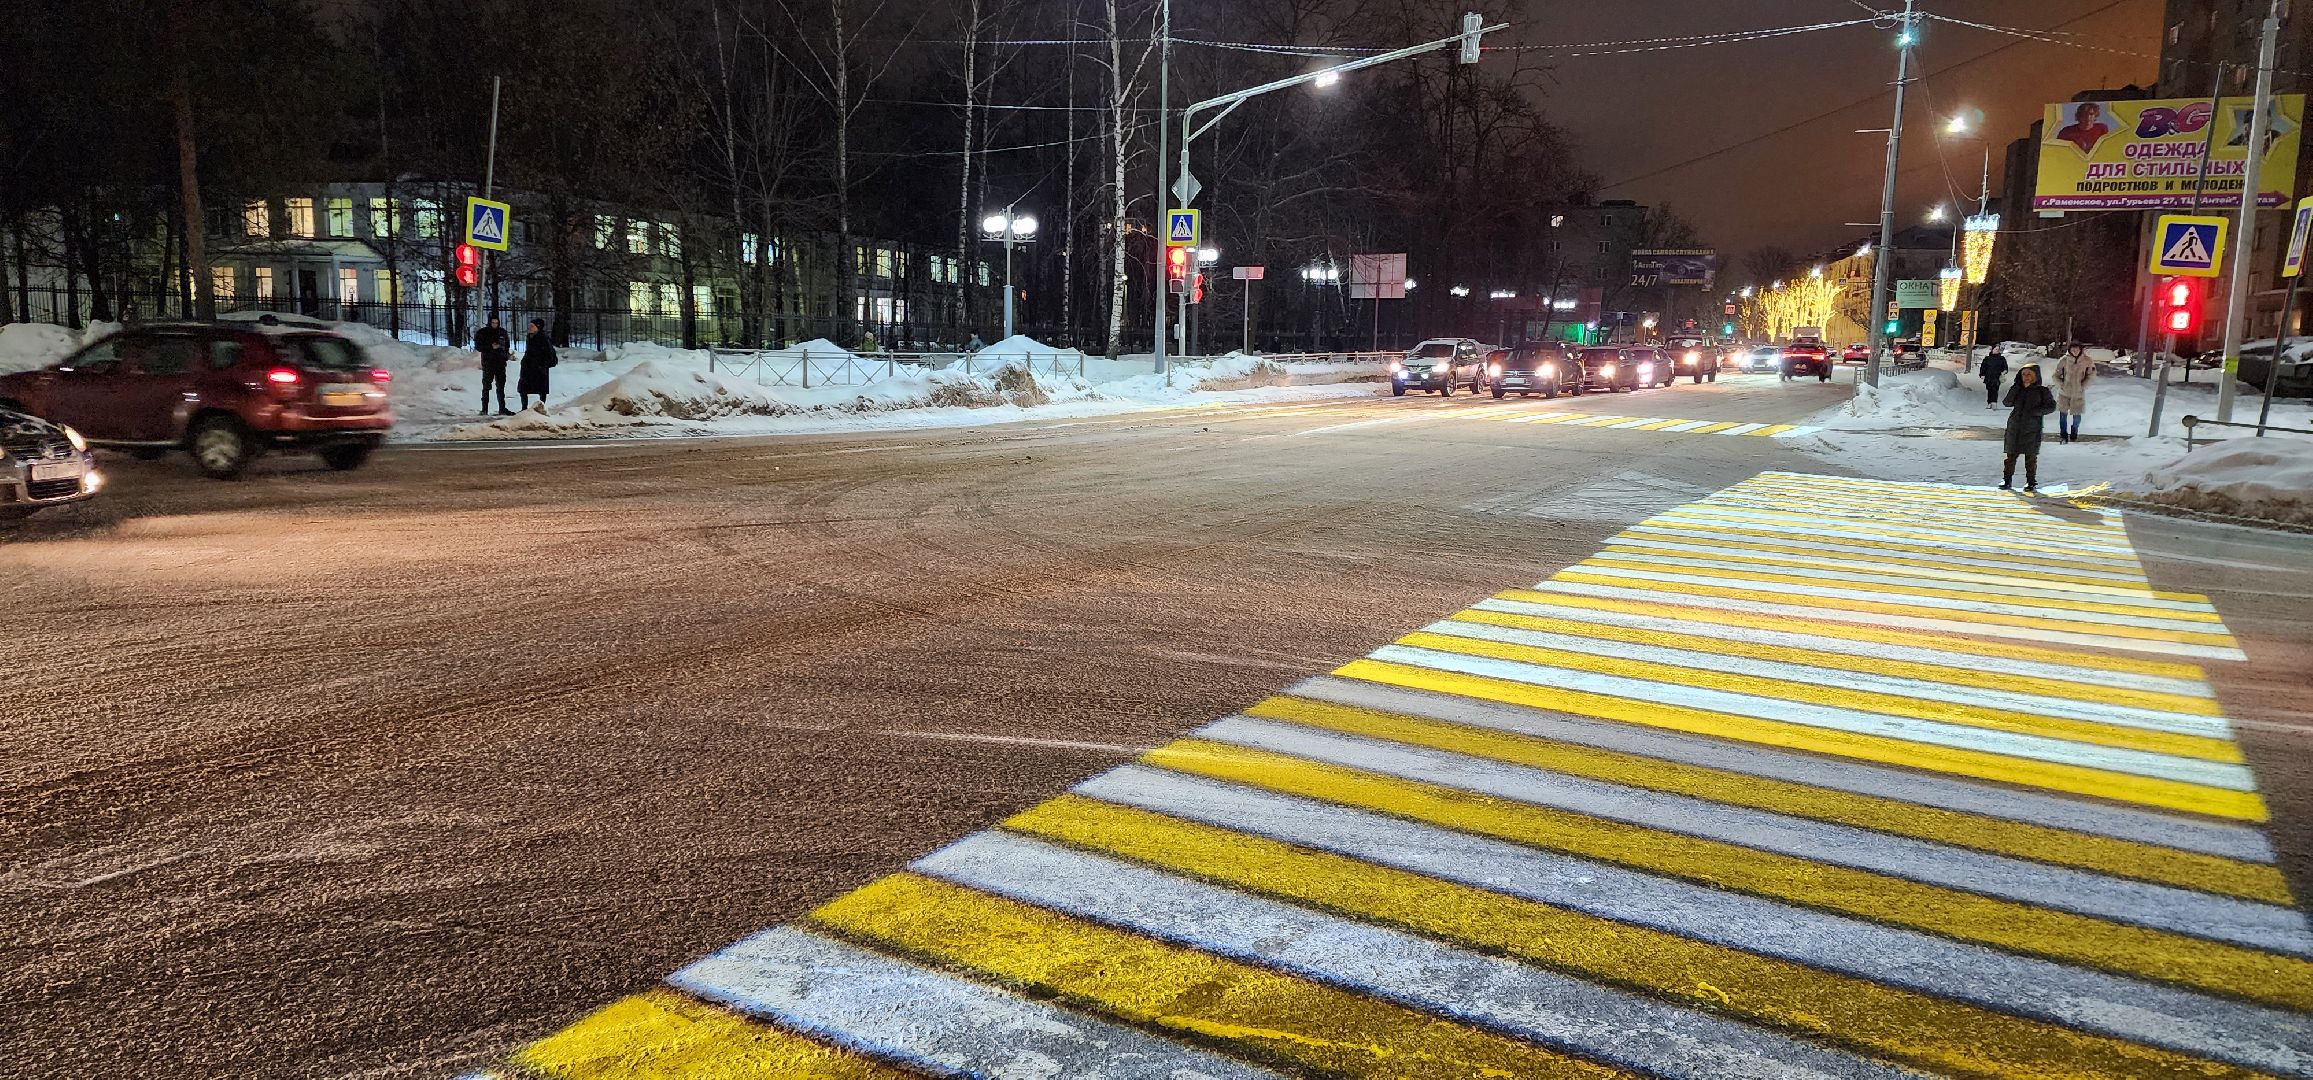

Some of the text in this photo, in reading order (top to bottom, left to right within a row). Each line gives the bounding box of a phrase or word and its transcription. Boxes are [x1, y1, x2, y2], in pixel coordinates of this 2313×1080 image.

[2086, 163, 2127, 179] ДЛЯ
[2077, 181, 2158, 193] ПОДРОСТКОВ
[2165, 181, 2174, 191] И
[2042, 198, 2105, 206] г.Раменское,
[2162, 198, 2178, 206] 27,
[1631, 274, 1658, 288] 24/7
[1899, 281, 1930, 290] ОКНА
